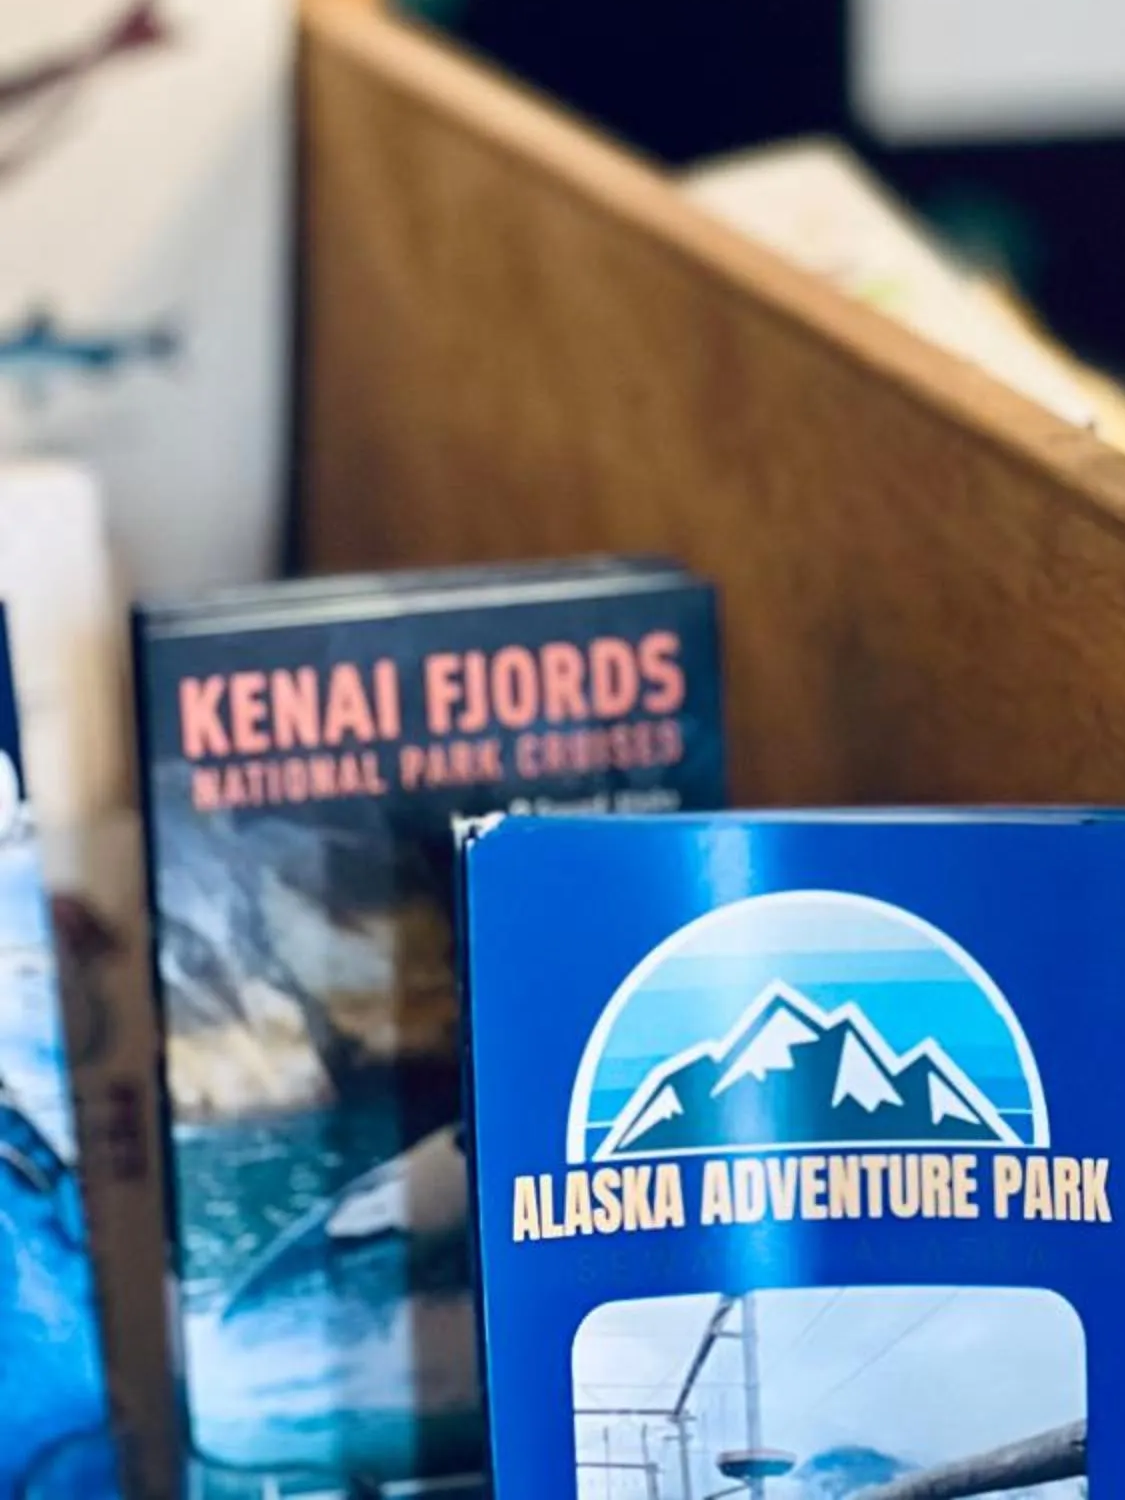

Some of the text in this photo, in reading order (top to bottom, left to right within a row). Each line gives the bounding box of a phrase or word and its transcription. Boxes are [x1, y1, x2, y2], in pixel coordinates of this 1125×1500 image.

[179, 630, 686, 759] KENAI FJORDS
[191, 720, 685, 812] NATIONAL PARK CRUISES
[512, 1153, 1113, 1242] ALASKA ADVENTURE PARK
